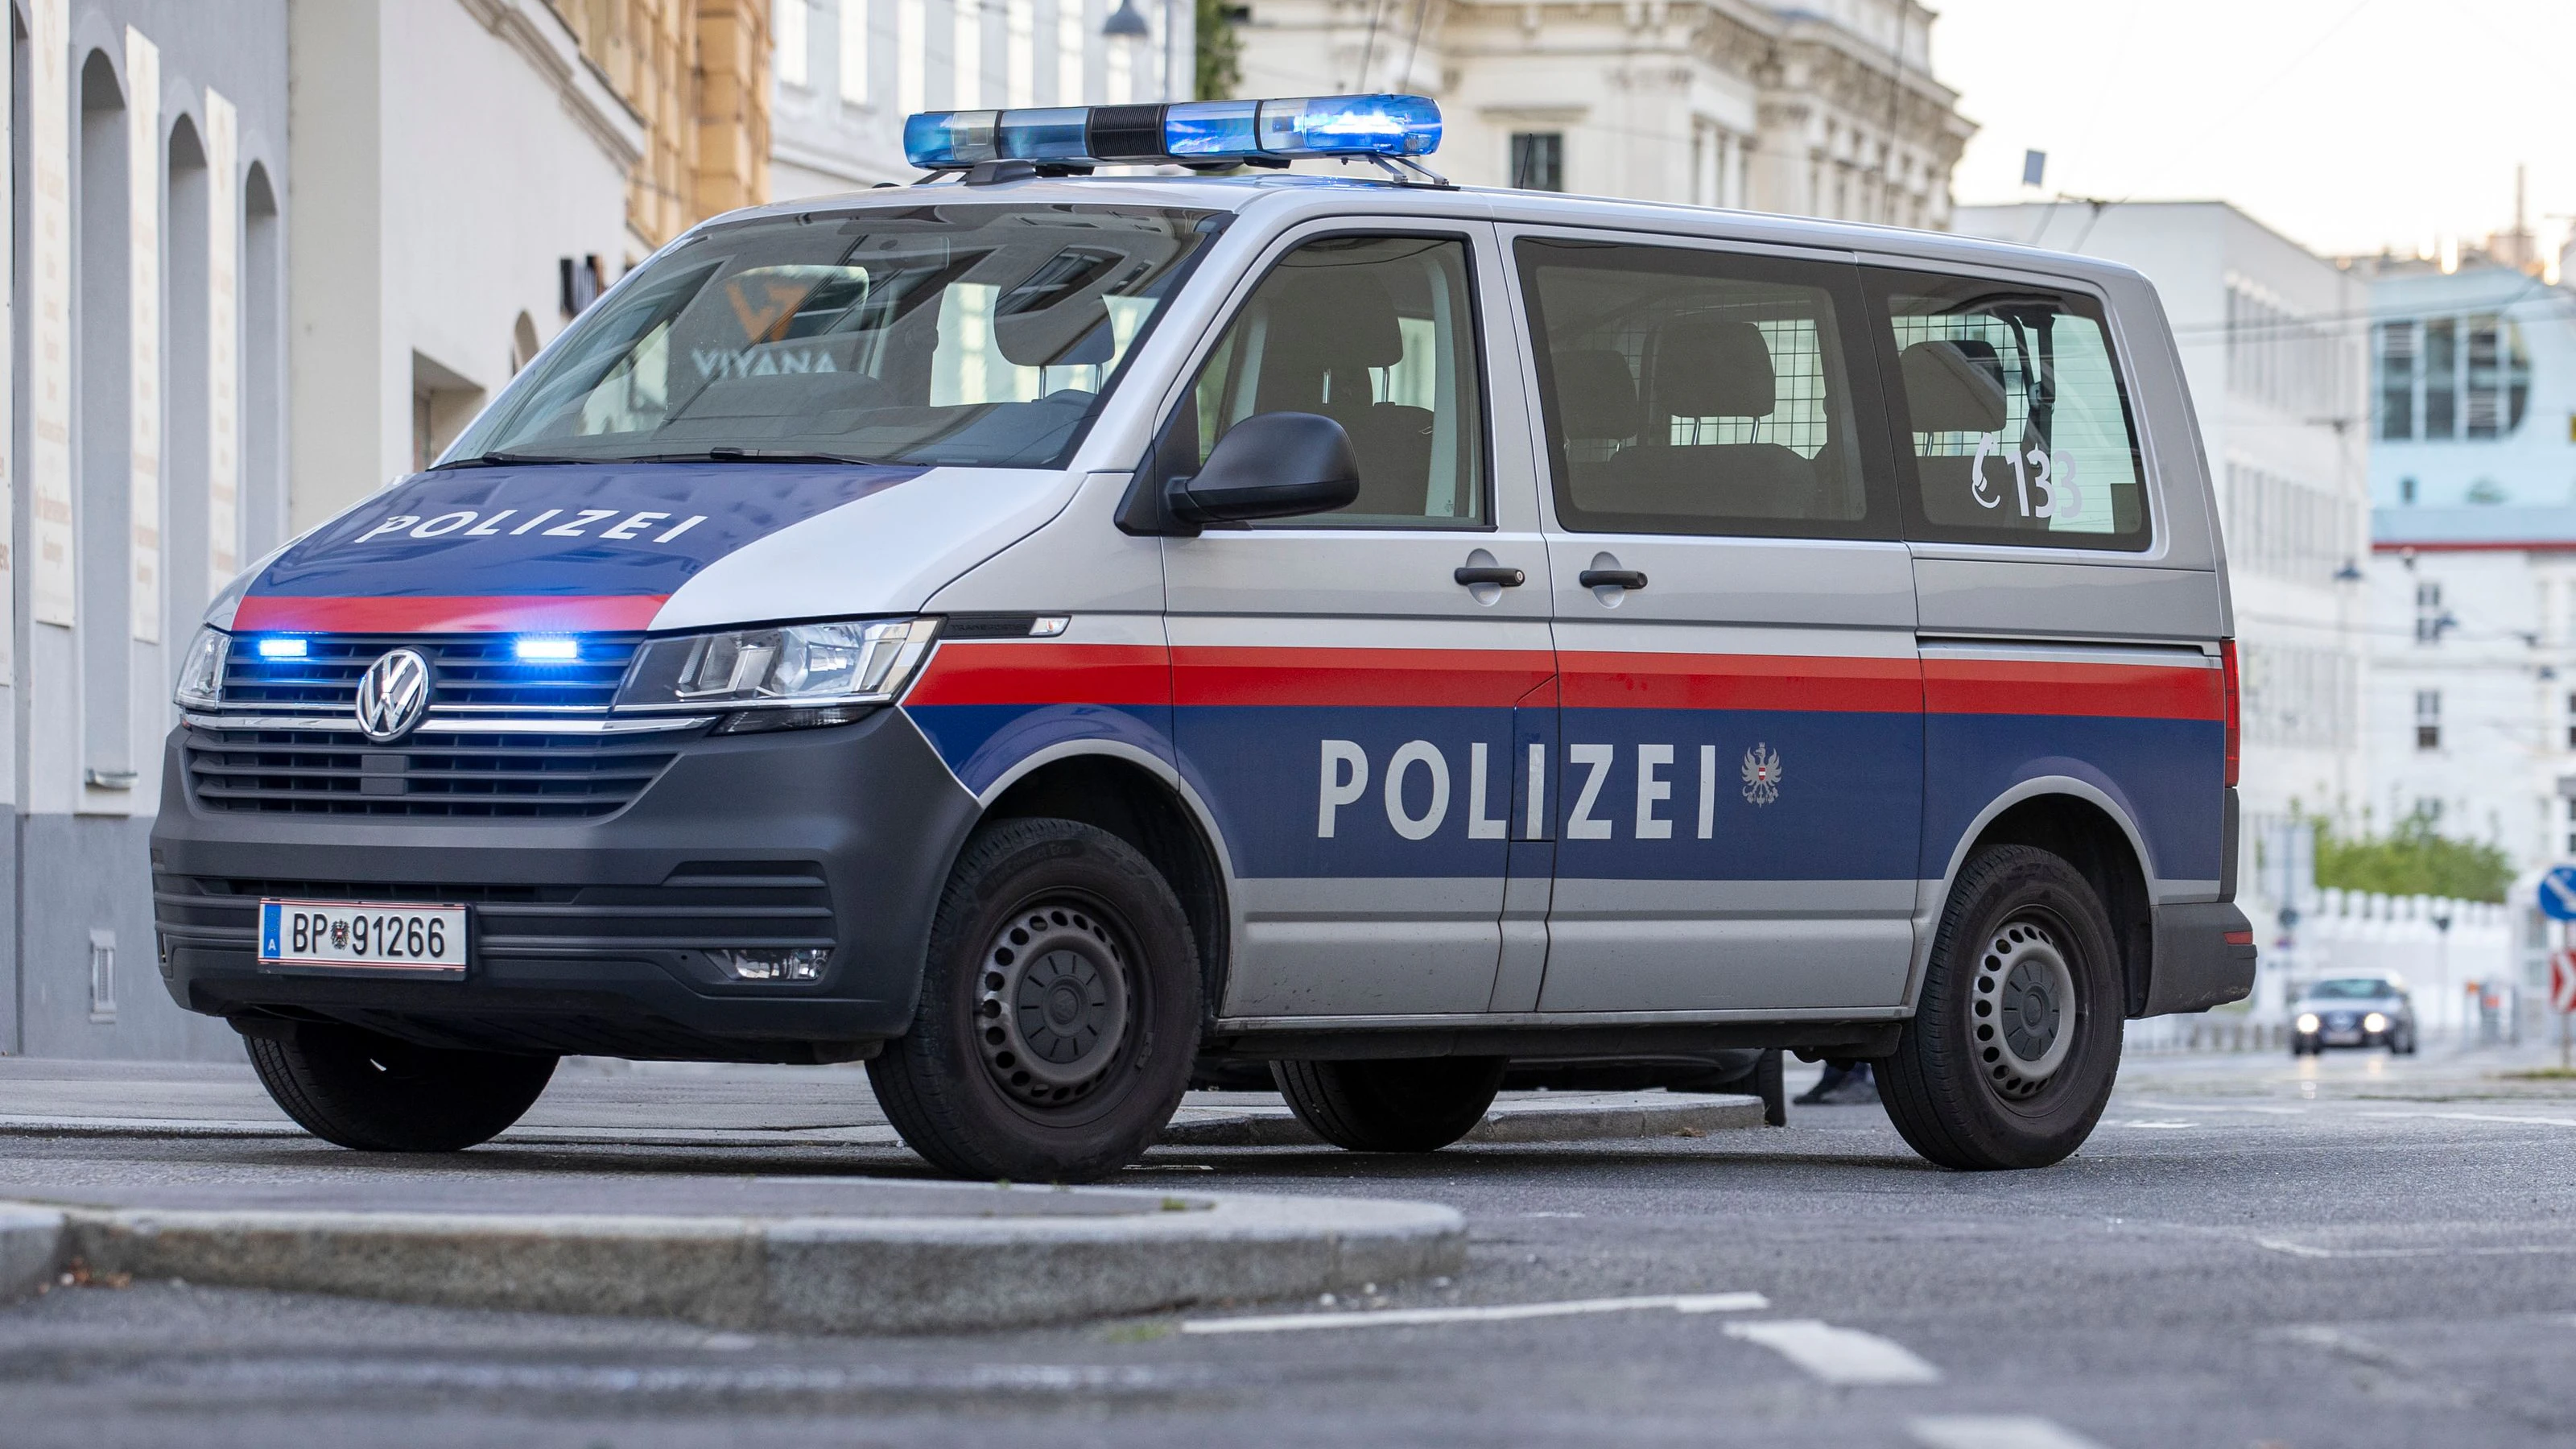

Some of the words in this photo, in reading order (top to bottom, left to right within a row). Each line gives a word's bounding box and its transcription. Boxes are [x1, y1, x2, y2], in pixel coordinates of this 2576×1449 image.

[691, 347, 838, 379] VIVANA
[2004, 448, 2083, 518] 133
[354, 509, 708, 543] POLIZEI
[1318, 739, 1715, 840] POLIZEI
[267, 939, 276, 951] A
[293, 913, 328, 953] BP
[352, 915, 444, 958] 91266
